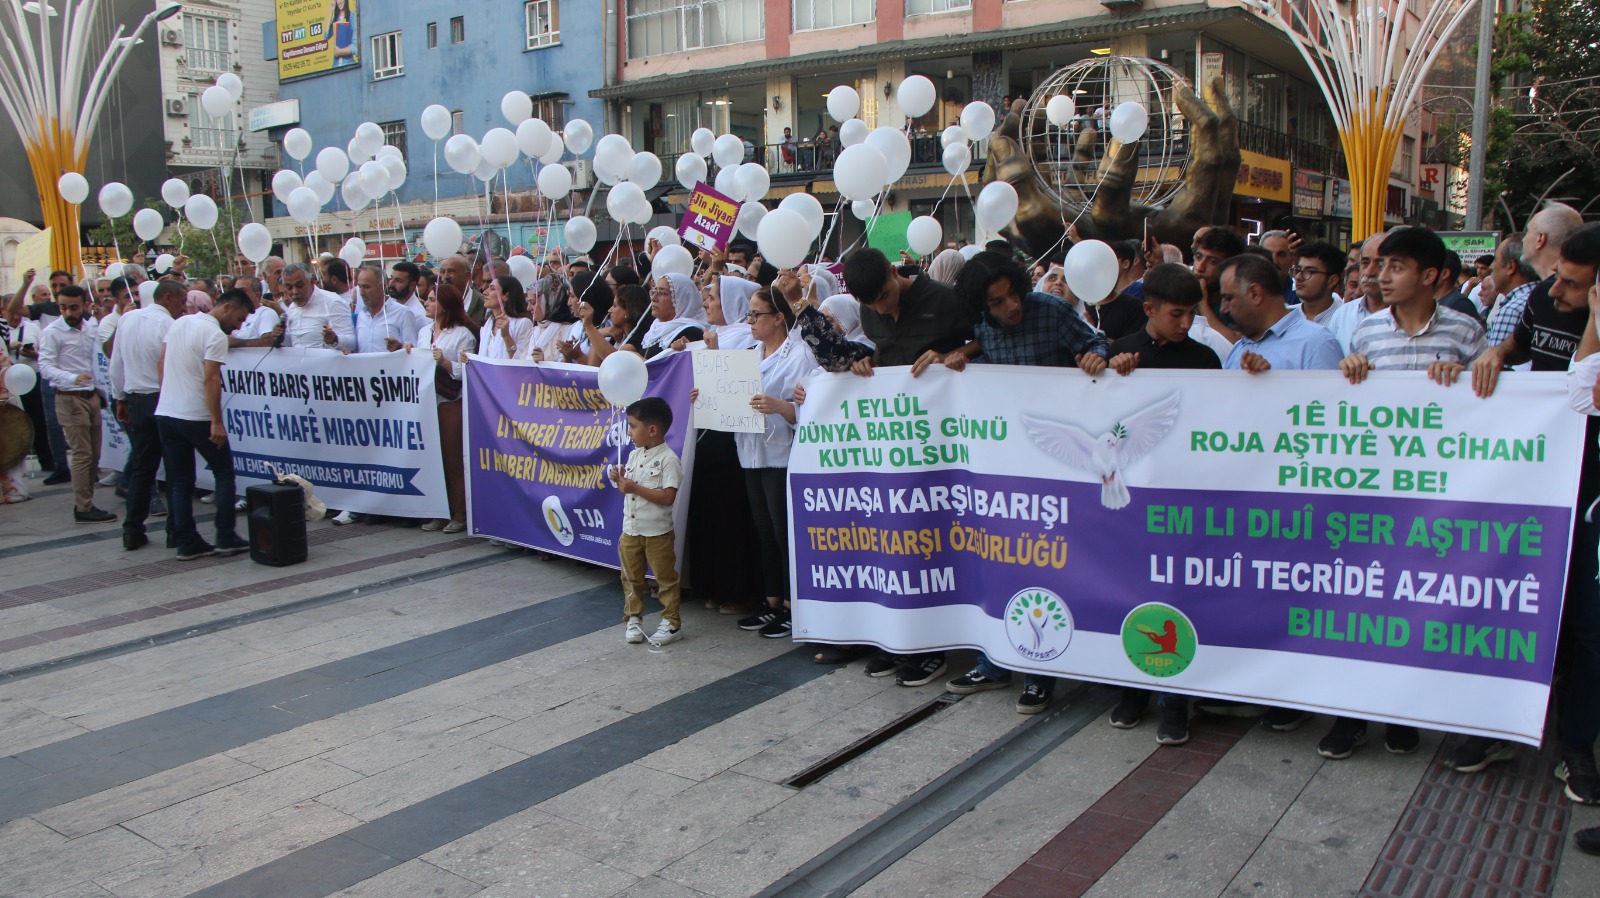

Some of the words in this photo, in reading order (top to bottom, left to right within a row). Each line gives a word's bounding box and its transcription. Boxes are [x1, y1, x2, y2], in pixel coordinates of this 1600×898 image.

[282, 32, 292, 42] TYT
[294, 29, 305, 40] AYT
[311, 24, 321, 35] LGS
[693, 194, 707, 209] Jin
[709, 203, 732, 223] Jîyan
[694, 213, 720, 235] Azadî
[1532, 330, 1550, 347] A7
[1549, 336, 1576, 352] EMPO
[227, 370, 267, 396] HAYIR
[270, 372, 309, 405] BARIŞ
[313, 376, 367, 402] HEMEN
[370, 369, 420, 407] ŞİMDİ!
[518, 383, 532, 406] LI
[840, 400, 849, 419] 1
[857, 393, 928, 418] EYLÜL
[1286, 400, 1326, 426] 1Ê
[1338, 400, 1443, 429] ÎLONÊ
[227, 404, 274, 441] AŞTIYÊ
[277, 408, 321, 443] MAFÊ
[323, 417, 403, 449] MIROVAN
[407, 421, 425, 450] E!
[497, 415, 509, 438] LI
[799, 421, 861, 444] DÜNYA
[867, 419, 931, 445] BARIŞ
[940, 413, 1007, 441] GÜNÜ
[480, 448, 490, 470] LI
[819, 447, 883, 467] KUTLU
[889, 443, 969, 466] OLSUN
[1190, 430, 1264, 453] ROJA
[1273, 429, 1377, 460] AŞTIYÊ
[1388, 435, 1426, 458] YA
[1436, 432, 1546, 462] CÎHANÎ
[345, 469, 404, 489] PLATFORMU
[1278, 461, 1380, 490] PÎROZ
[1393, 469, 1448, 493] BE!
[573, 509, 604, 529] TJA
[803, 486, 883, 517] SAVAŞA
[888, 484, 973, 516] KARŞI
[973, 489, 1069, 530] BARIŞI
[807, 521, 878, 551] TECRİDE
[880, 527, 941, 560] KARŞI
[950, 520, 1068, 569] ÖZGÜRLÜĞÜ
[1146, 504, 1194, 535] EM
[1206, 507, 1234, 537] LI
[1247, 503, 1314, 540] DIJÎ
[1325, 510, 1395, 550] ŞER
[1405, 516, 1543, 557] AŞTIYÊ
[811, 565, 955, 595] HAYKIRALIM
[1150, 554, 1174, 584] LI
[1185, 552, 1243, 588] DIJÎ
[1252, 557, 1385, 598] TECRÎDÊ
[1393, 570, 1540, 614] AZADIYÊ
[1287, 606, 1411, 647] BILIND
[1423, 619, 1537, 663] BIKIN
[1018, 644, 1034, 657] DEM
[1145, 656, 1173, 668] DBP
